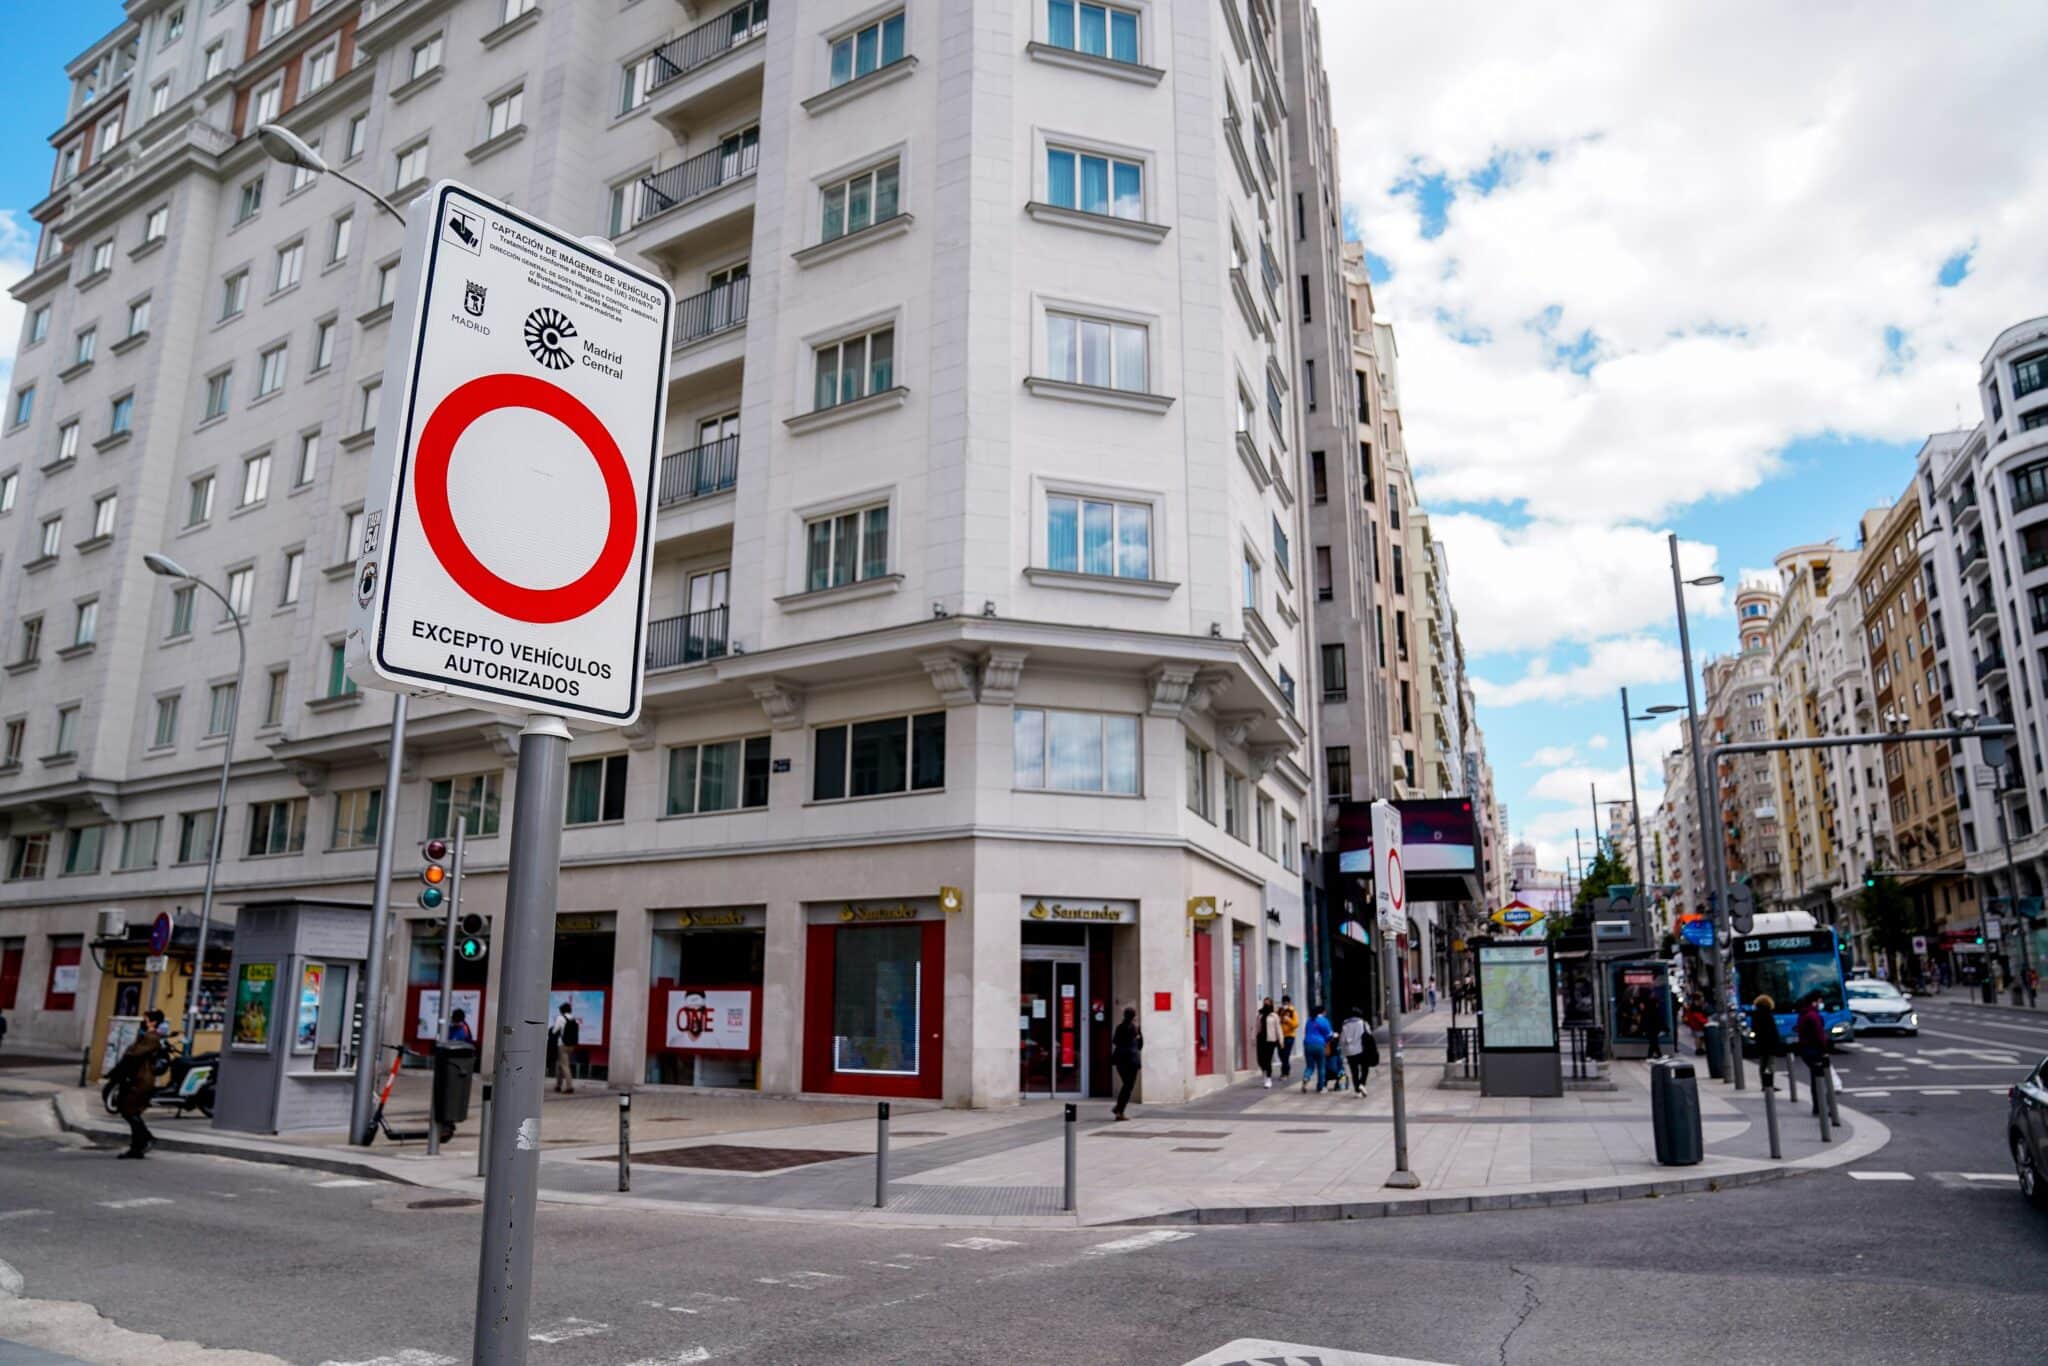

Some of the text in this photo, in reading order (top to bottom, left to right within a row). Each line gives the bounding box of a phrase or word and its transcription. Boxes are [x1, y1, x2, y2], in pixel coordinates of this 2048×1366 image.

[492, 222, 662, 306] CAPTACIÓN DE IMÁGENES DE VEHÍCULOS
[500, 235, 538, 258] Tratamiento
[540, 255, 570, 272] conforme
[578, 271, 614, 292] Reglamento
[614, 288, 628, 300] (UE)
[490, 243, 520, 261] DIRECCIÓN
[522, 258, 548, 274] GENERAL
[548, 270, 556, 278] DE
[558, 274, 600, 298] SOSTENIBILIDAD
[606, 296, 630, 311] CONTROL
[630, 308, 658, 324] AMBIENTAL
[528, 276, 540, 286] Más
[580, 301, 622, 323] www.madrid.es
[584, 294, 600, 306] 28045
[452, 314, 491, 336] MADRID
[582, 354, 623, 380] Central
[583, 340, 622, 365] Madrid
[412, 620, 612, 680] EXCEPTO VEHÍCULOS
[444, 654, 580, 696] AUTORIZADOS
[1051, 903, 1121, 920] Santander
[676, 1008, 715, 1032] ONE
